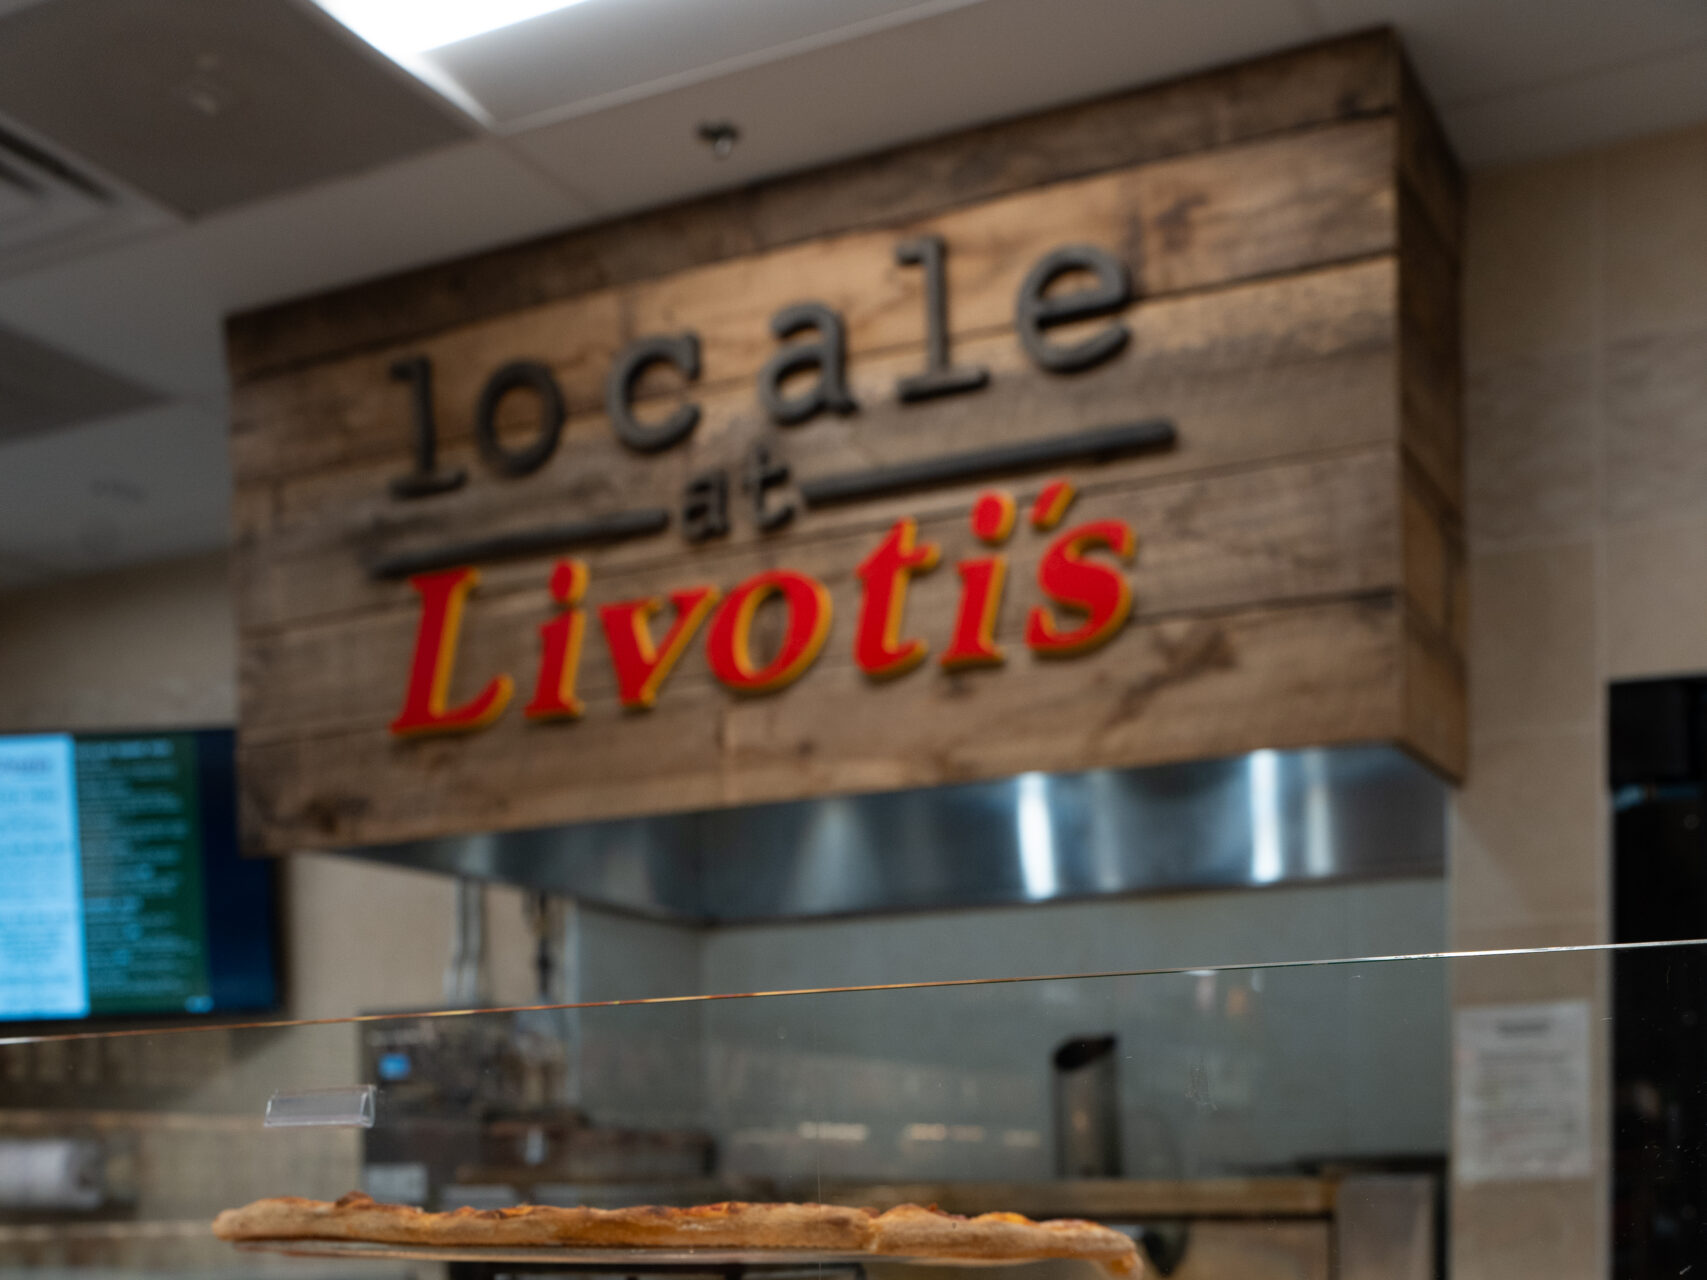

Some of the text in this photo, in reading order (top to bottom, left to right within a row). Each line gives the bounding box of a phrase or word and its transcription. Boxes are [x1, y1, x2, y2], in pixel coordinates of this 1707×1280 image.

[388, 233, 1135, 500] locale
[682, 443, 800, 543] at
[388, 481, 1139, 738] Livoti's
